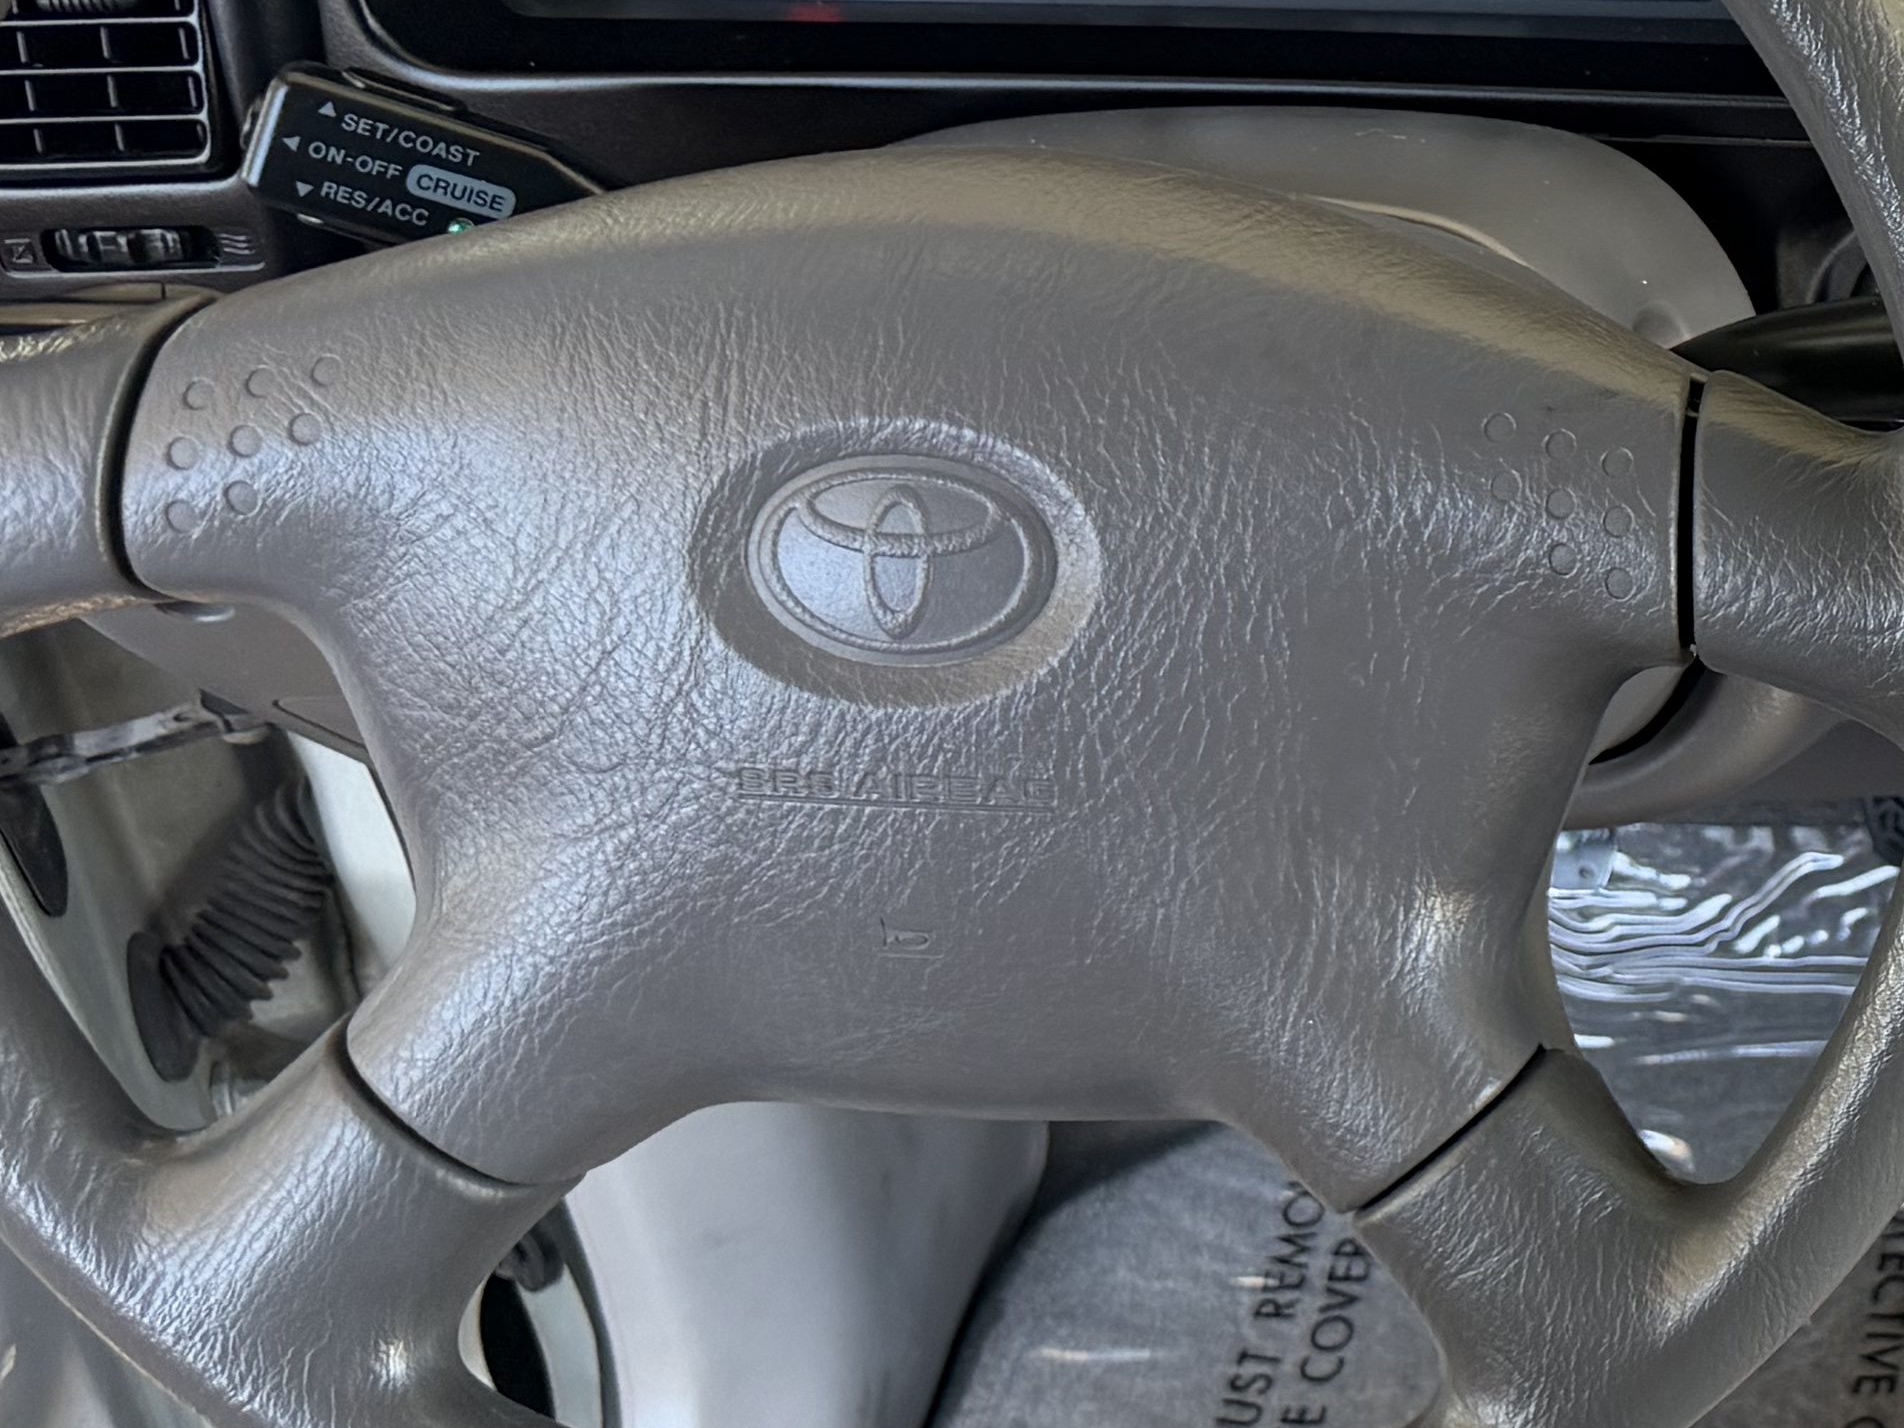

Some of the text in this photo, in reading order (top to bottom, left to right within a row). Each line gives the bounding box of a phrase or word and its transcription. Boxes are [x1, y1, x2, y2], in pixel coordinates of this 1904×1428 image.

[340, 113, 481, 167] SET/COAST
[308, 140, 507, 213] ON-OFF CRUISE
[320, 180, 430, 227] RES/ACC
[1253, 1181, 1326, 1321] REMO
